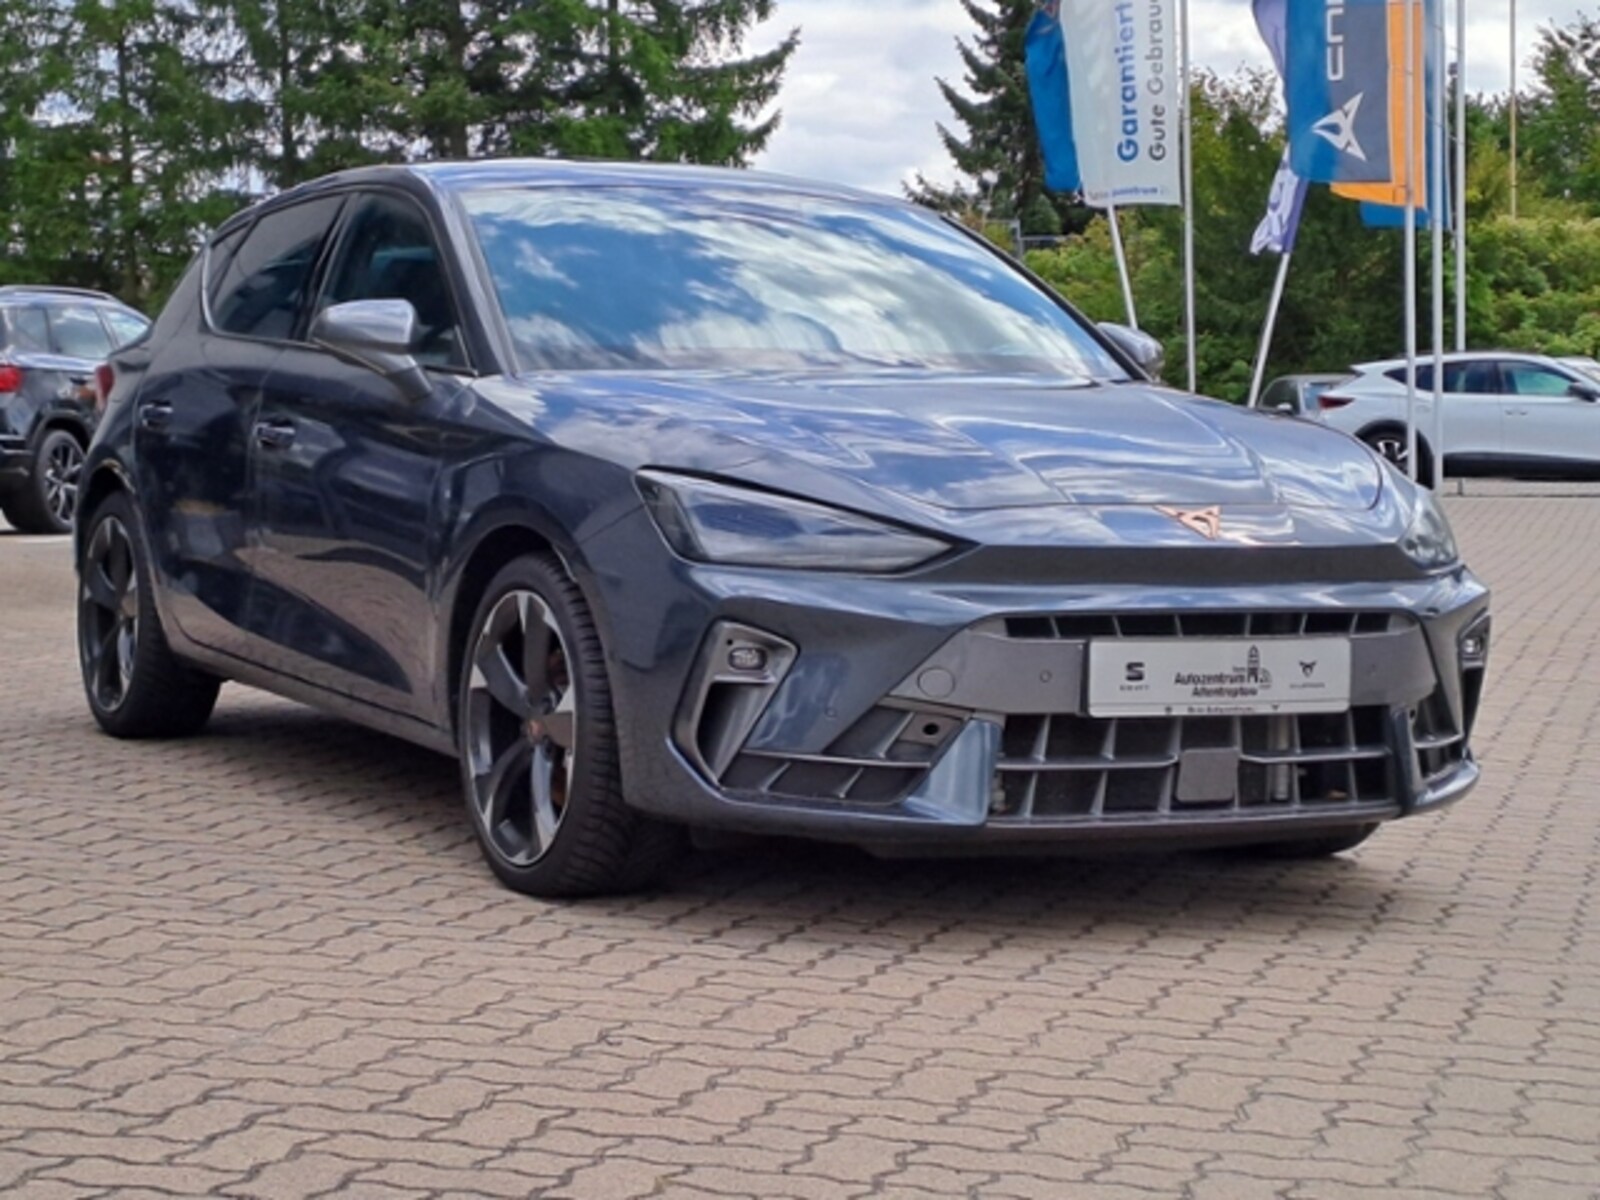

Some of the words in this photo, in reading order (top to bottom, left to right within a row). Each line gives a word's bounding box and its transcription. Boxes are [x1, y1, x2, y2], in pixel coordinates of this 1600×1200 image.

[1113, 1, 1139, 163] Garantiert
[1144, 0, 1164, 96] Gebrau
[1147, 103, 1167, 161] Gute
[1174, 672, 1246, 685] Autozentrum
